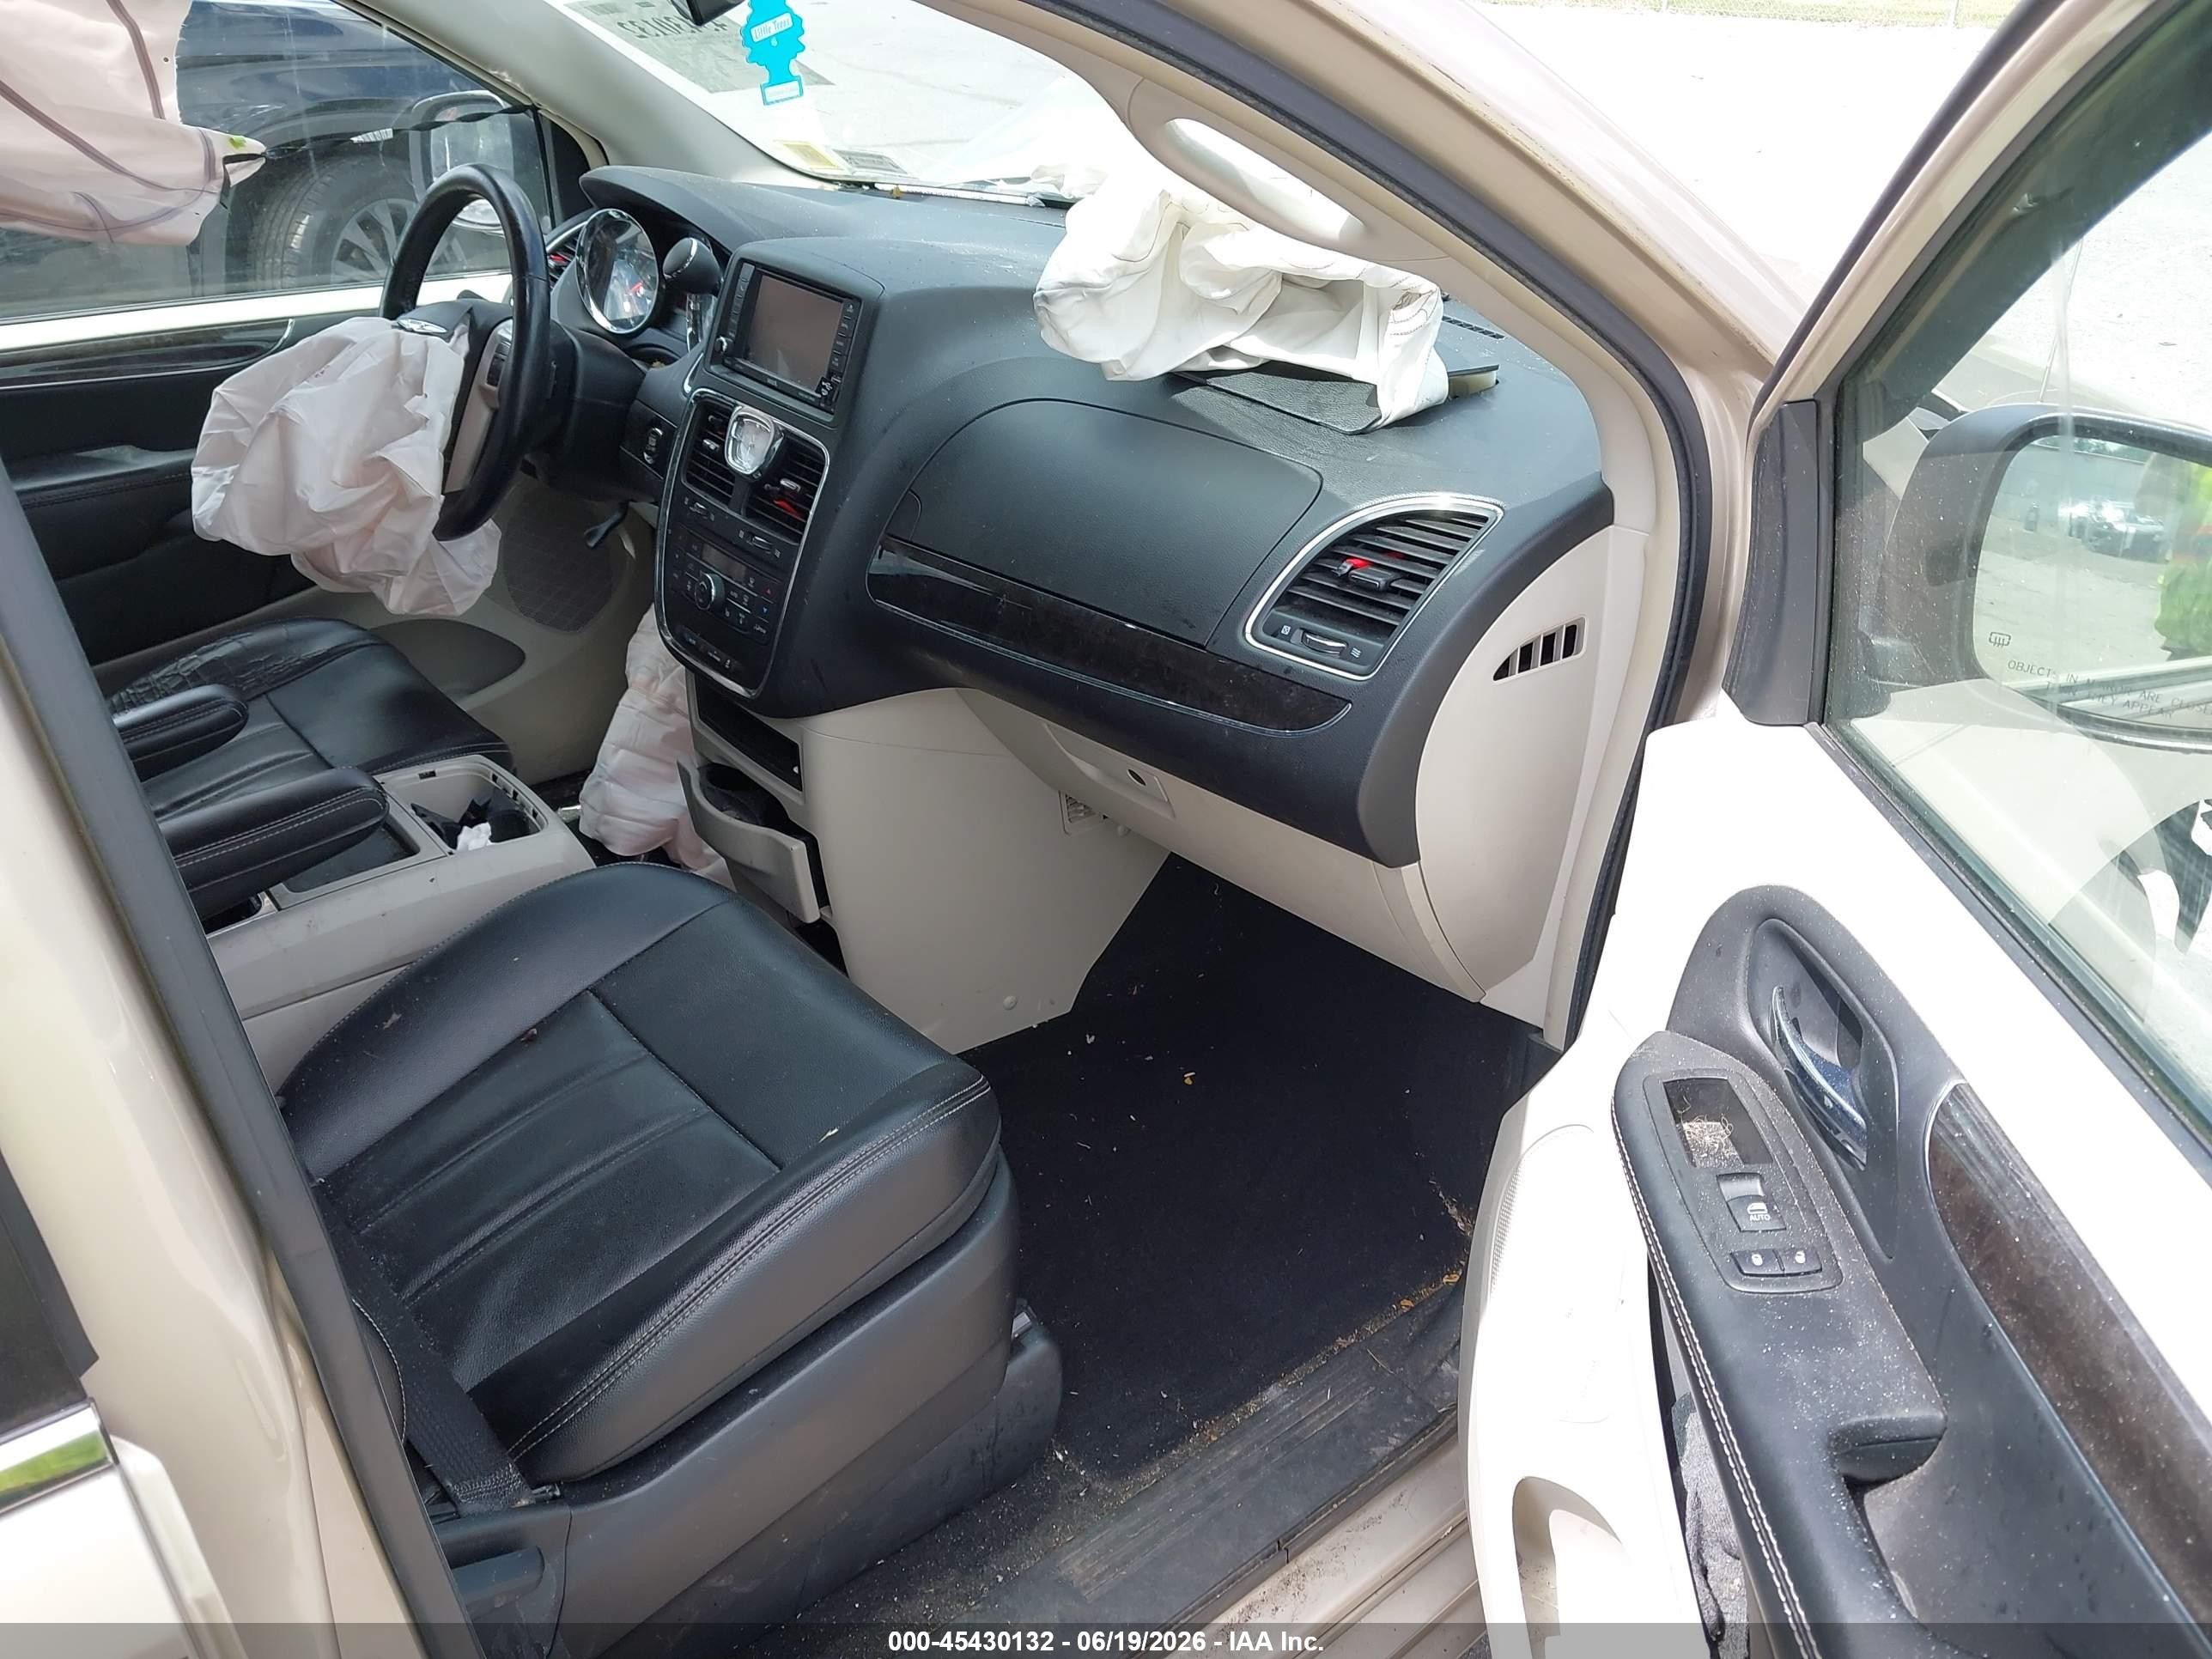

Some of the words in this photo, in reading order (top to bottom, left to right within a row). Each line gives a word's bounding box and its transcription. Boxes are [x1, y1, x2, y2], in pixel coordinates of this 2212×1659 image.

[753, 23, 772, 39] Little
[2067, 672, 2079, 684] IN
[2139, 689, 2164, 703] ARE
[2171, 696, 2212, 714] CLOSE
[1749, 1213, 1771, 1222] AUTO
